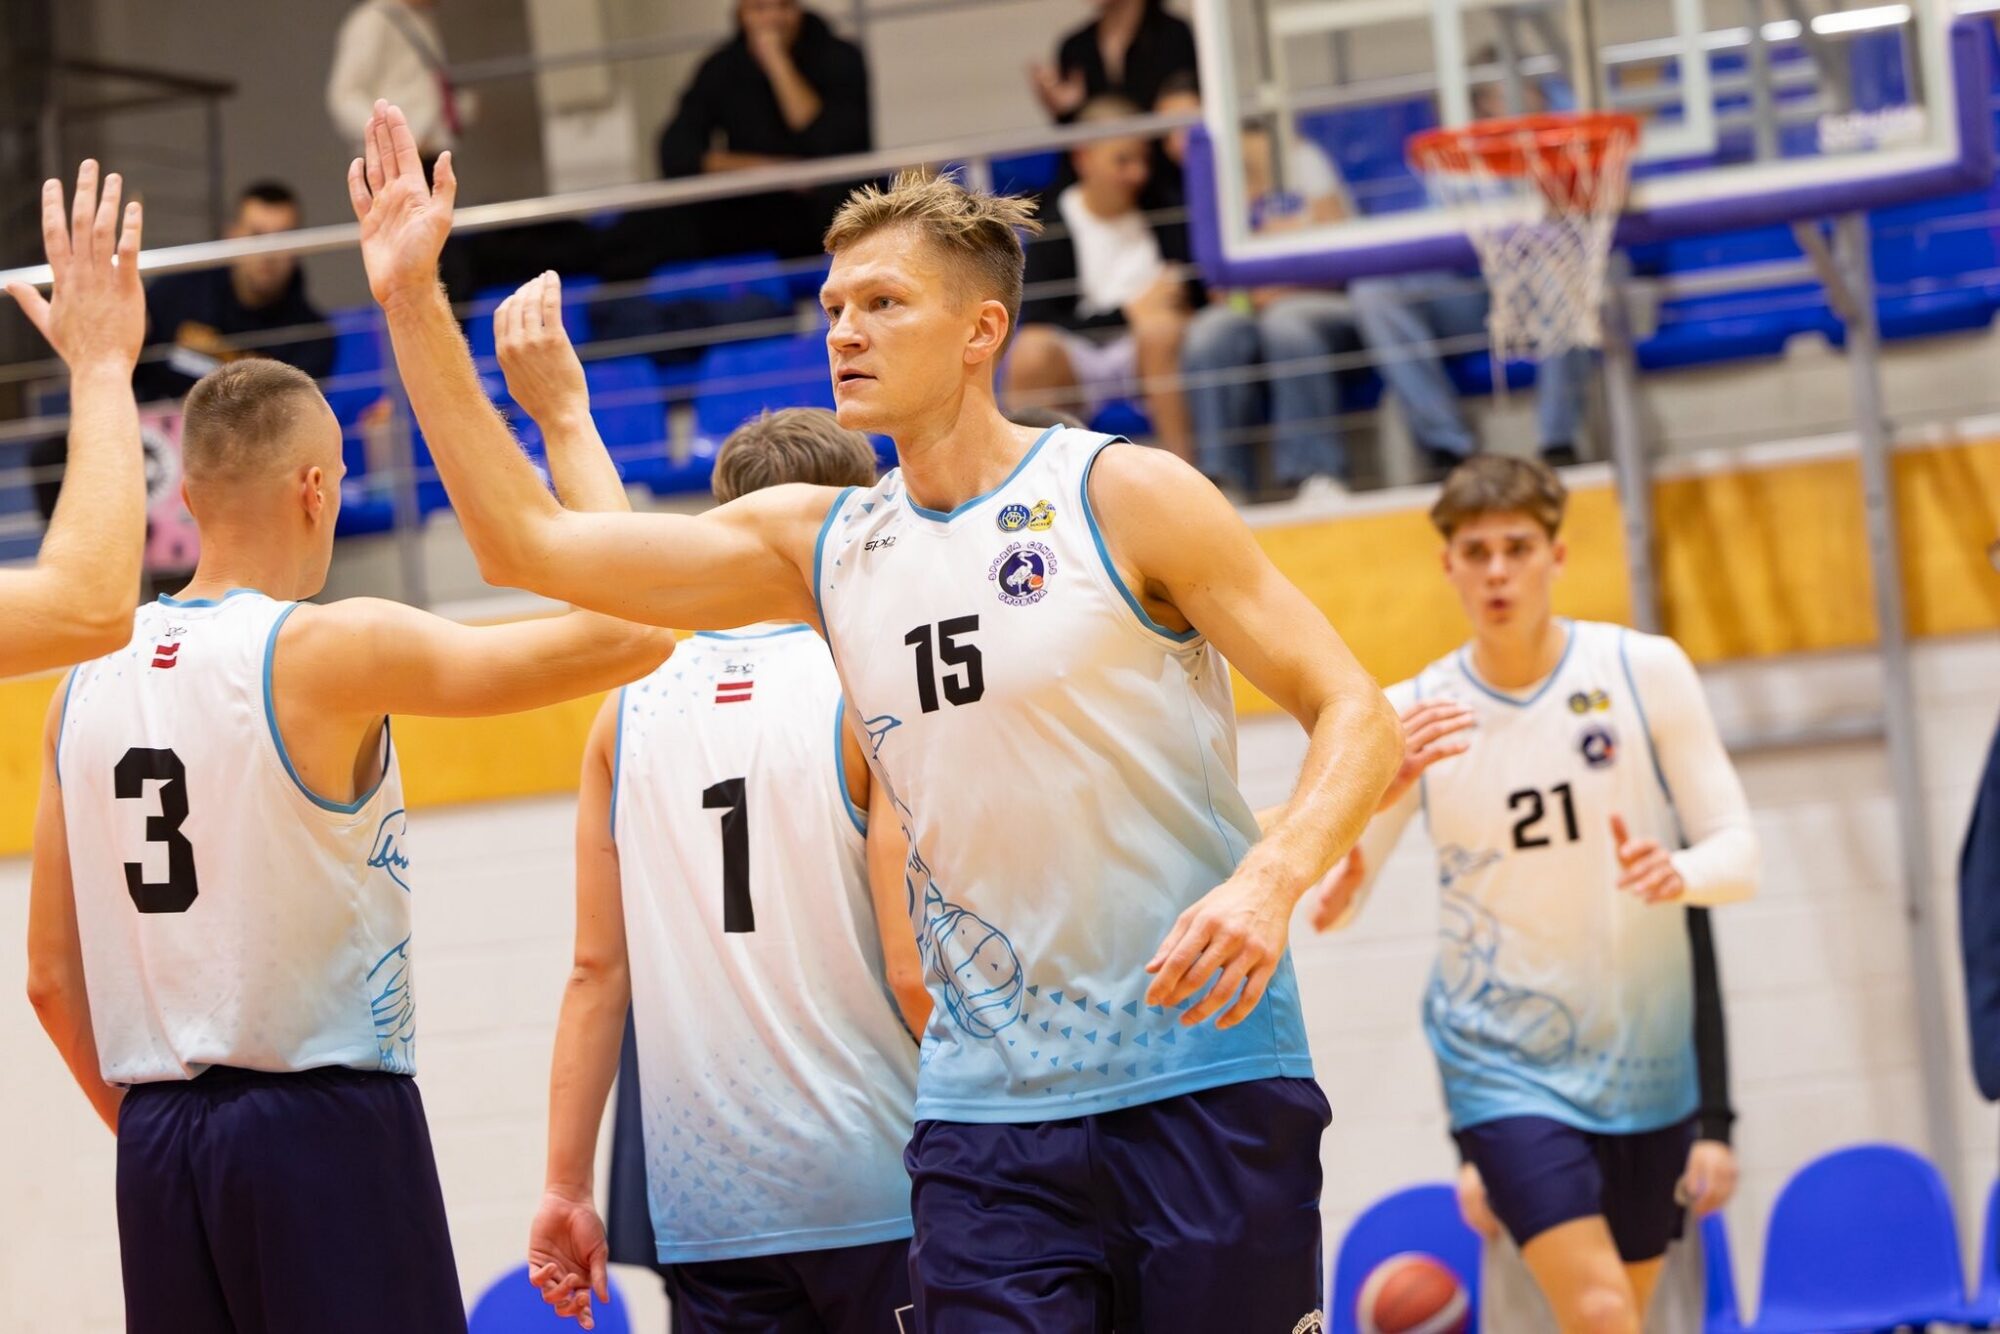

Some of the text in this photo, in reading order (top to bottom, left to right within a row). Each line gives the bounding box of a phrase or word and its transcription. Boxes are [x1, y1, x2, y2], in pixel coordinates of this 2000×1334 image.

[988, 541, 1058, 580] SPORTA CENTRS
[904, 614, 985, 714] 15
[113, 747, 199, 913] 3
[702, 776, 756, 933] 1
[1506, 781, 1580, 850] 21
